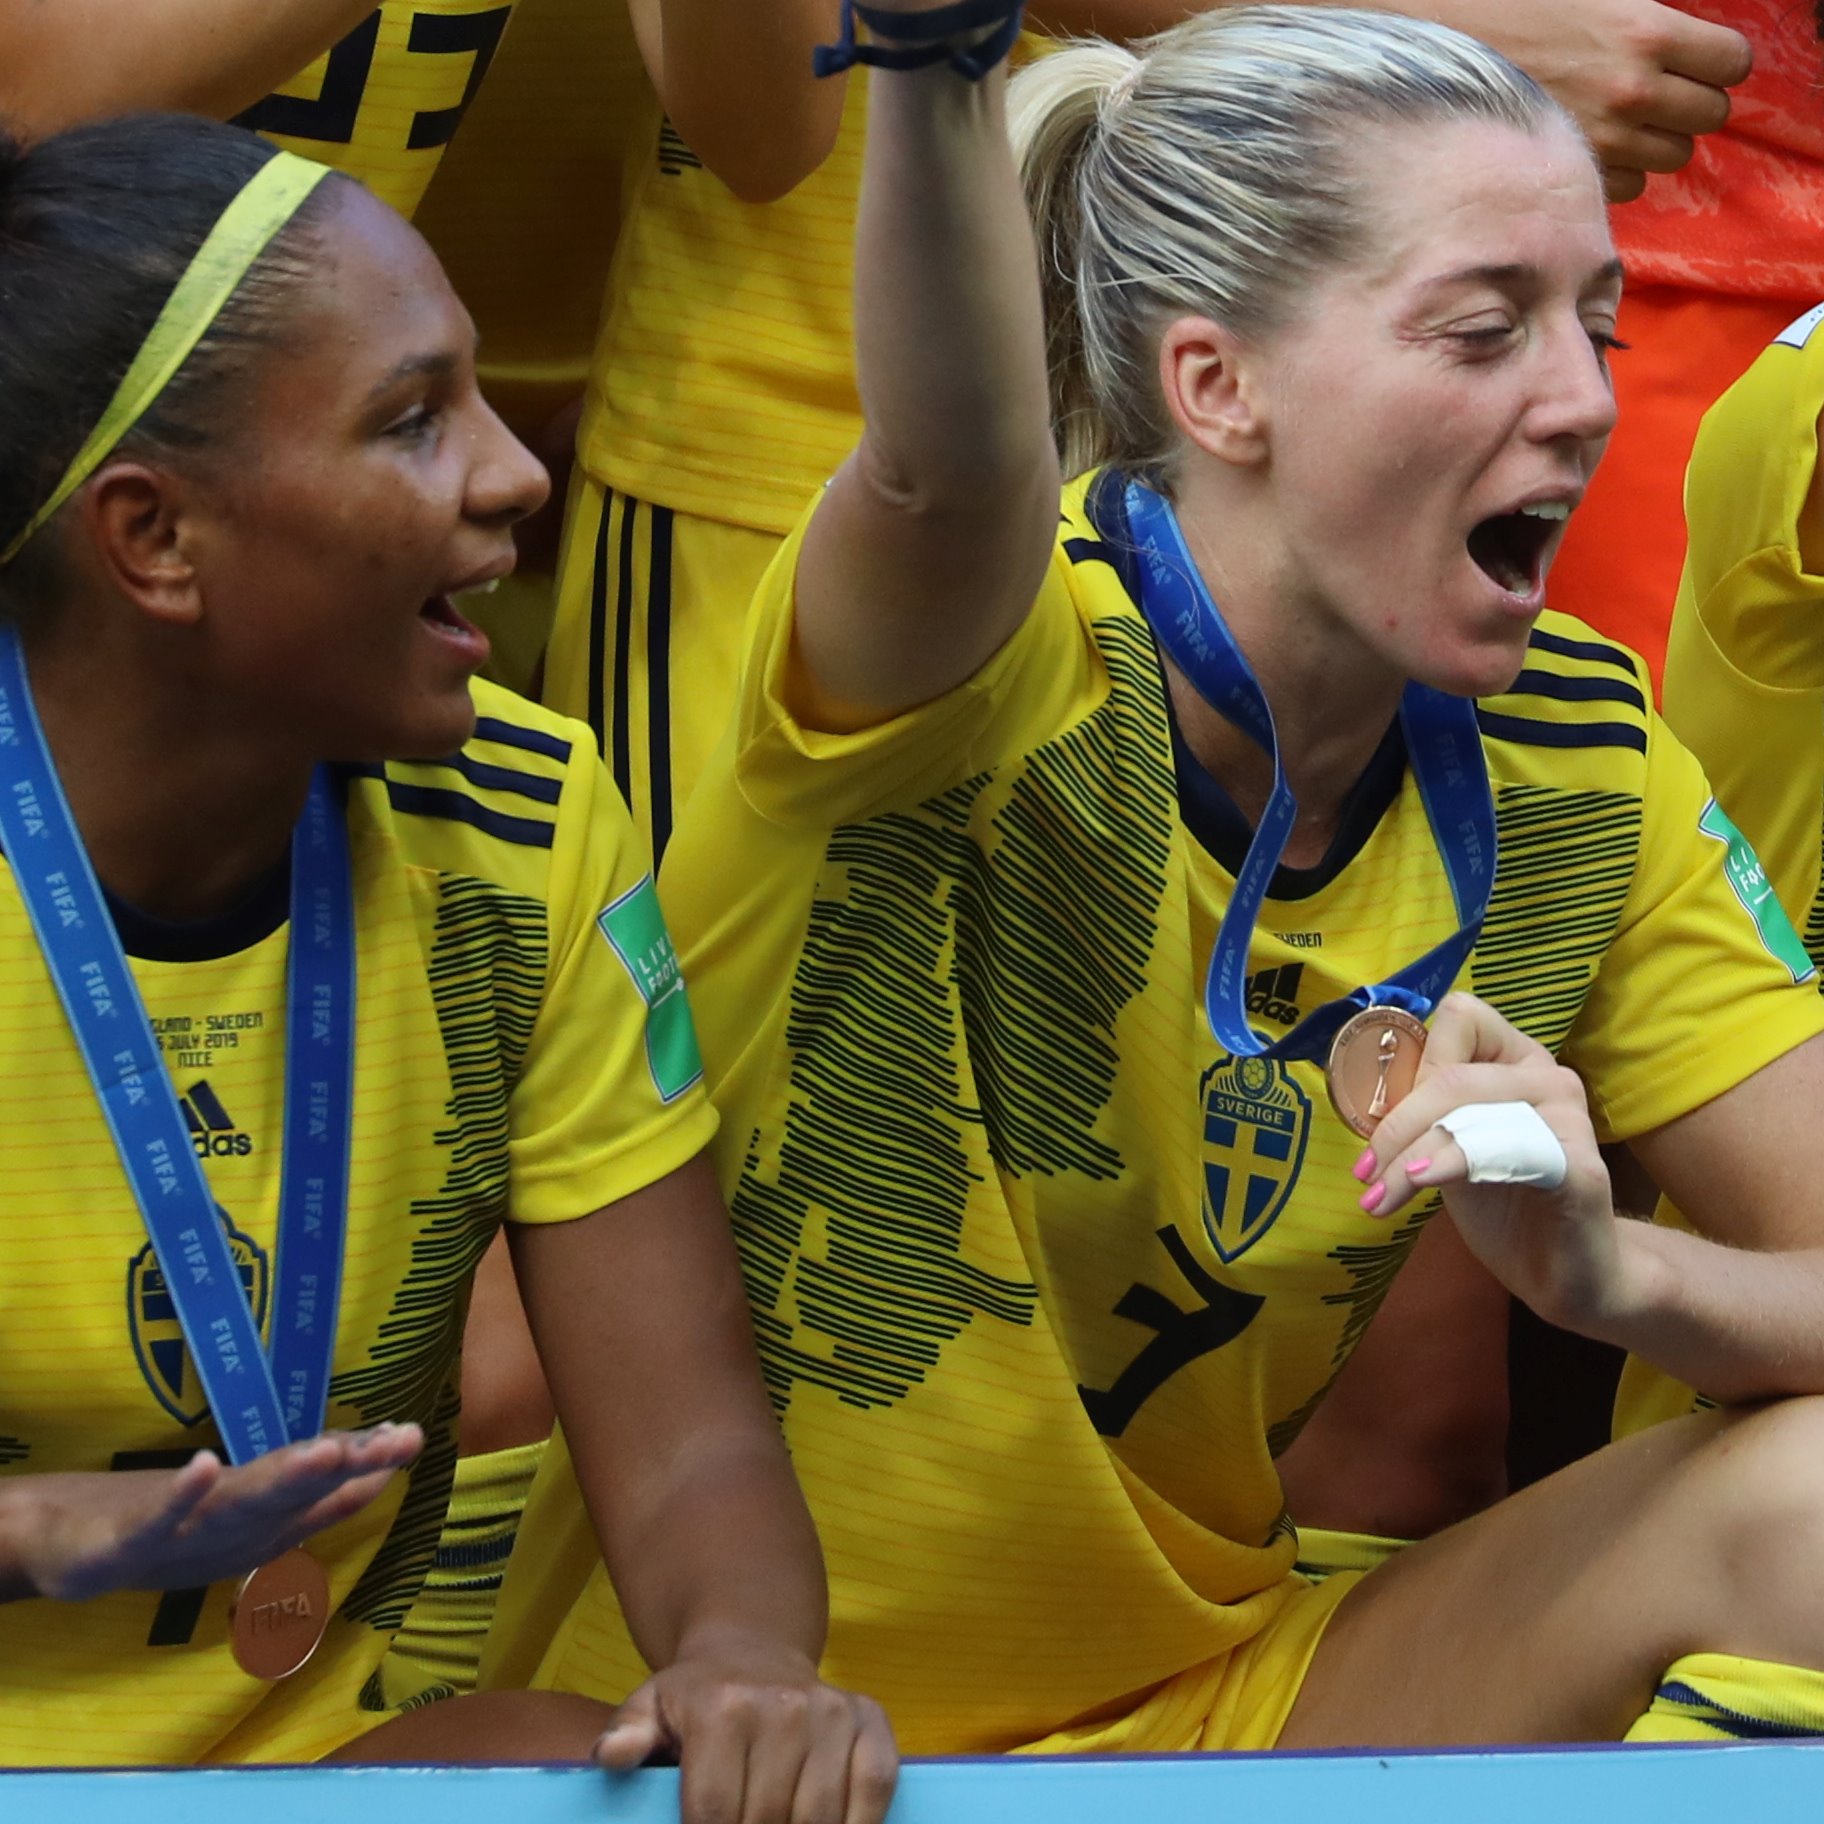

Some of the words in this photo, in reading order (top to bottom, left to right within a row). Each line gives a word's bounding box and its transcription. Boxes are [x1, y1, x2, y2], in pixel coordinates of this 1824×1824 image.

[1145, 536, 1167, 586] FIFA
[1176, 609, 1208, 662] FIFA
[1460, 820, 1482, 875] FIFA
[1219, 945, 1235, 999] FIFA
[150, 1015, 191, 1032] GLAND
[206, 1012, 263, 1030] SWEDEN
[167, 1034, 200, 1050] JULY
[206, 1034, 238, 1048] 2019
[14, 781, 42, 837] FIFA
[46, 873, 76, 927] FIFA
[81, 962, 110, 1017] FIFA
[115, 1051, 144, 1105] FIFA
[146, 1140, 175, 1195] FIFA
[179, 1229, 208, 1284] FIFA
[210, 1318, 237, 1373] FIFA
[178, 1052, 214, 1067] NICE
[1216, 1095, 1284, 1124] SVERIGE
[251, 1592, 312, 1635] FIFA
